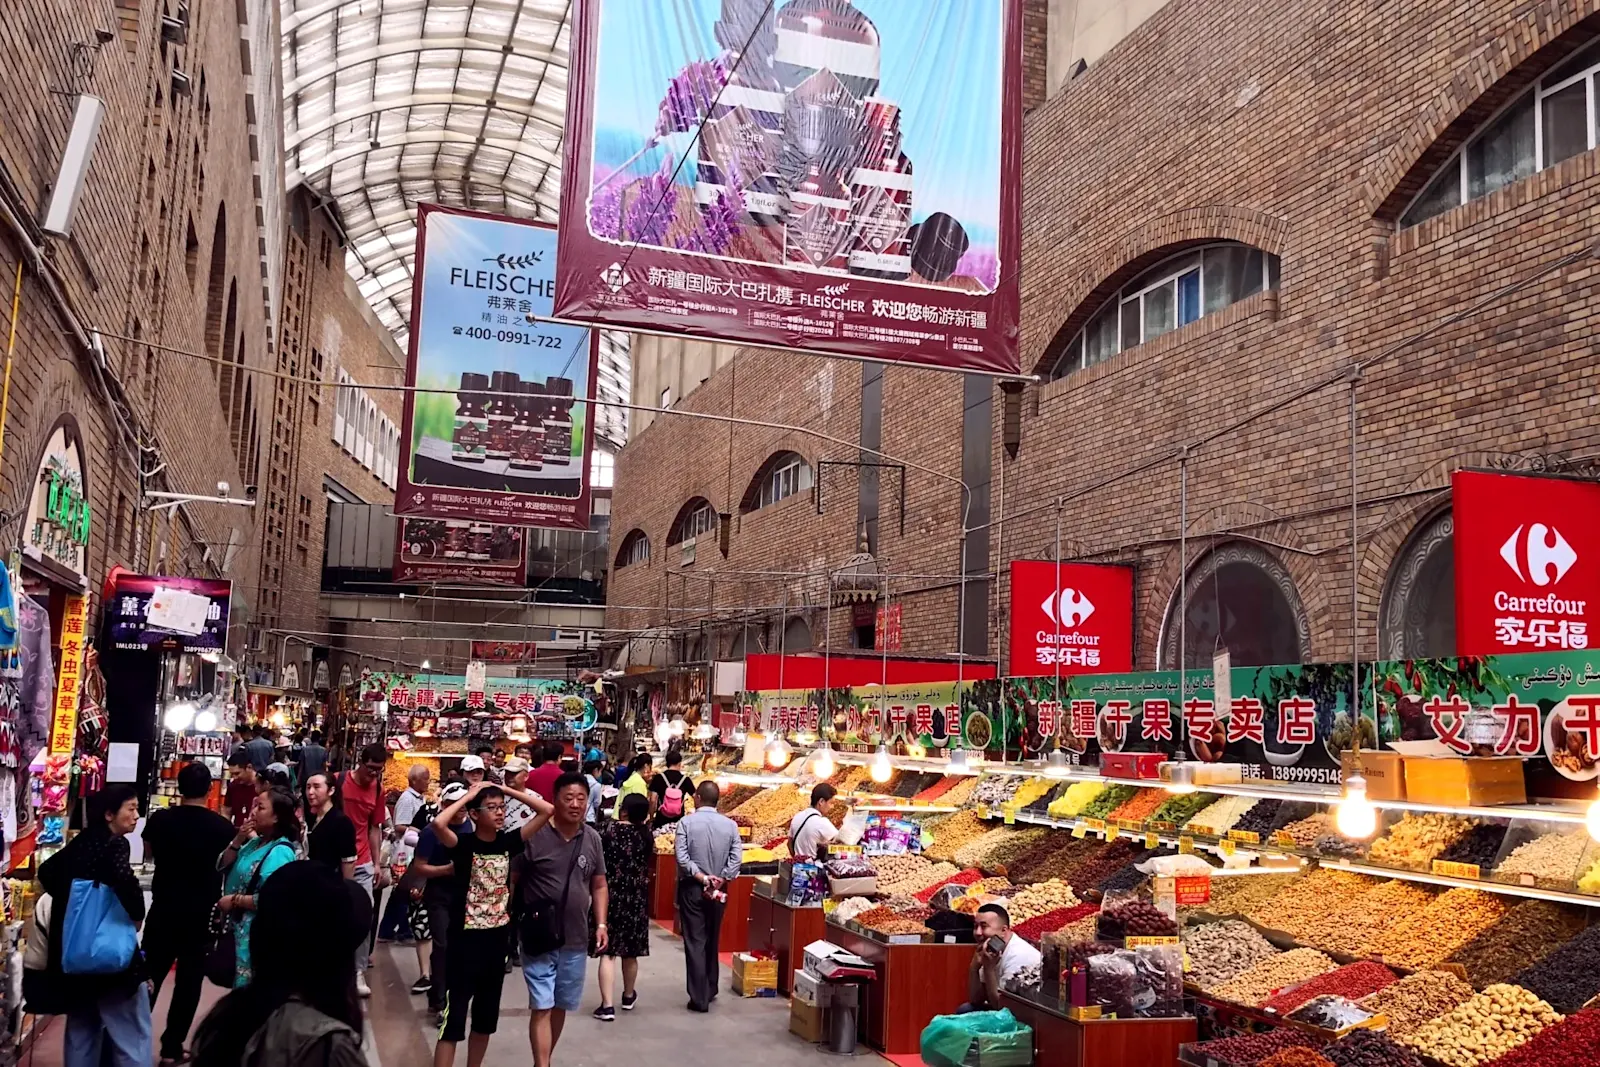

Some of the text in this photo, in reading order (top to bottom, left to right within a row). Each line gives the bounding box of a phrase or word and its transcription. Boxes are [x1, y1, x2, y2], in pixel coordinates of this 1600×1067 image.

[648, 266, 793, 306] 新疆国际大巴扎携
[487, 295, 532, 314] 弗莱舍
[800, 292, 866, 313] FLEISCHER
[871, 299, 987, 330] 欢迎您畅游新疆
[465, 326, 562, 349] 400-0991-722
[1494, 591, 1587, 616] Carrefour
[1036, 630, 1100, 647] Carrefour
[1494, 617, 1589, 649] 家乐福
[1036, 647, 1101, 667] 家乐福
[390, 687, 560, 712] 新疆干果专卖店
[849, 703, 962, 736] 外力干果店
[1037, 694, 1316, 745] 新疆干果专卖店
